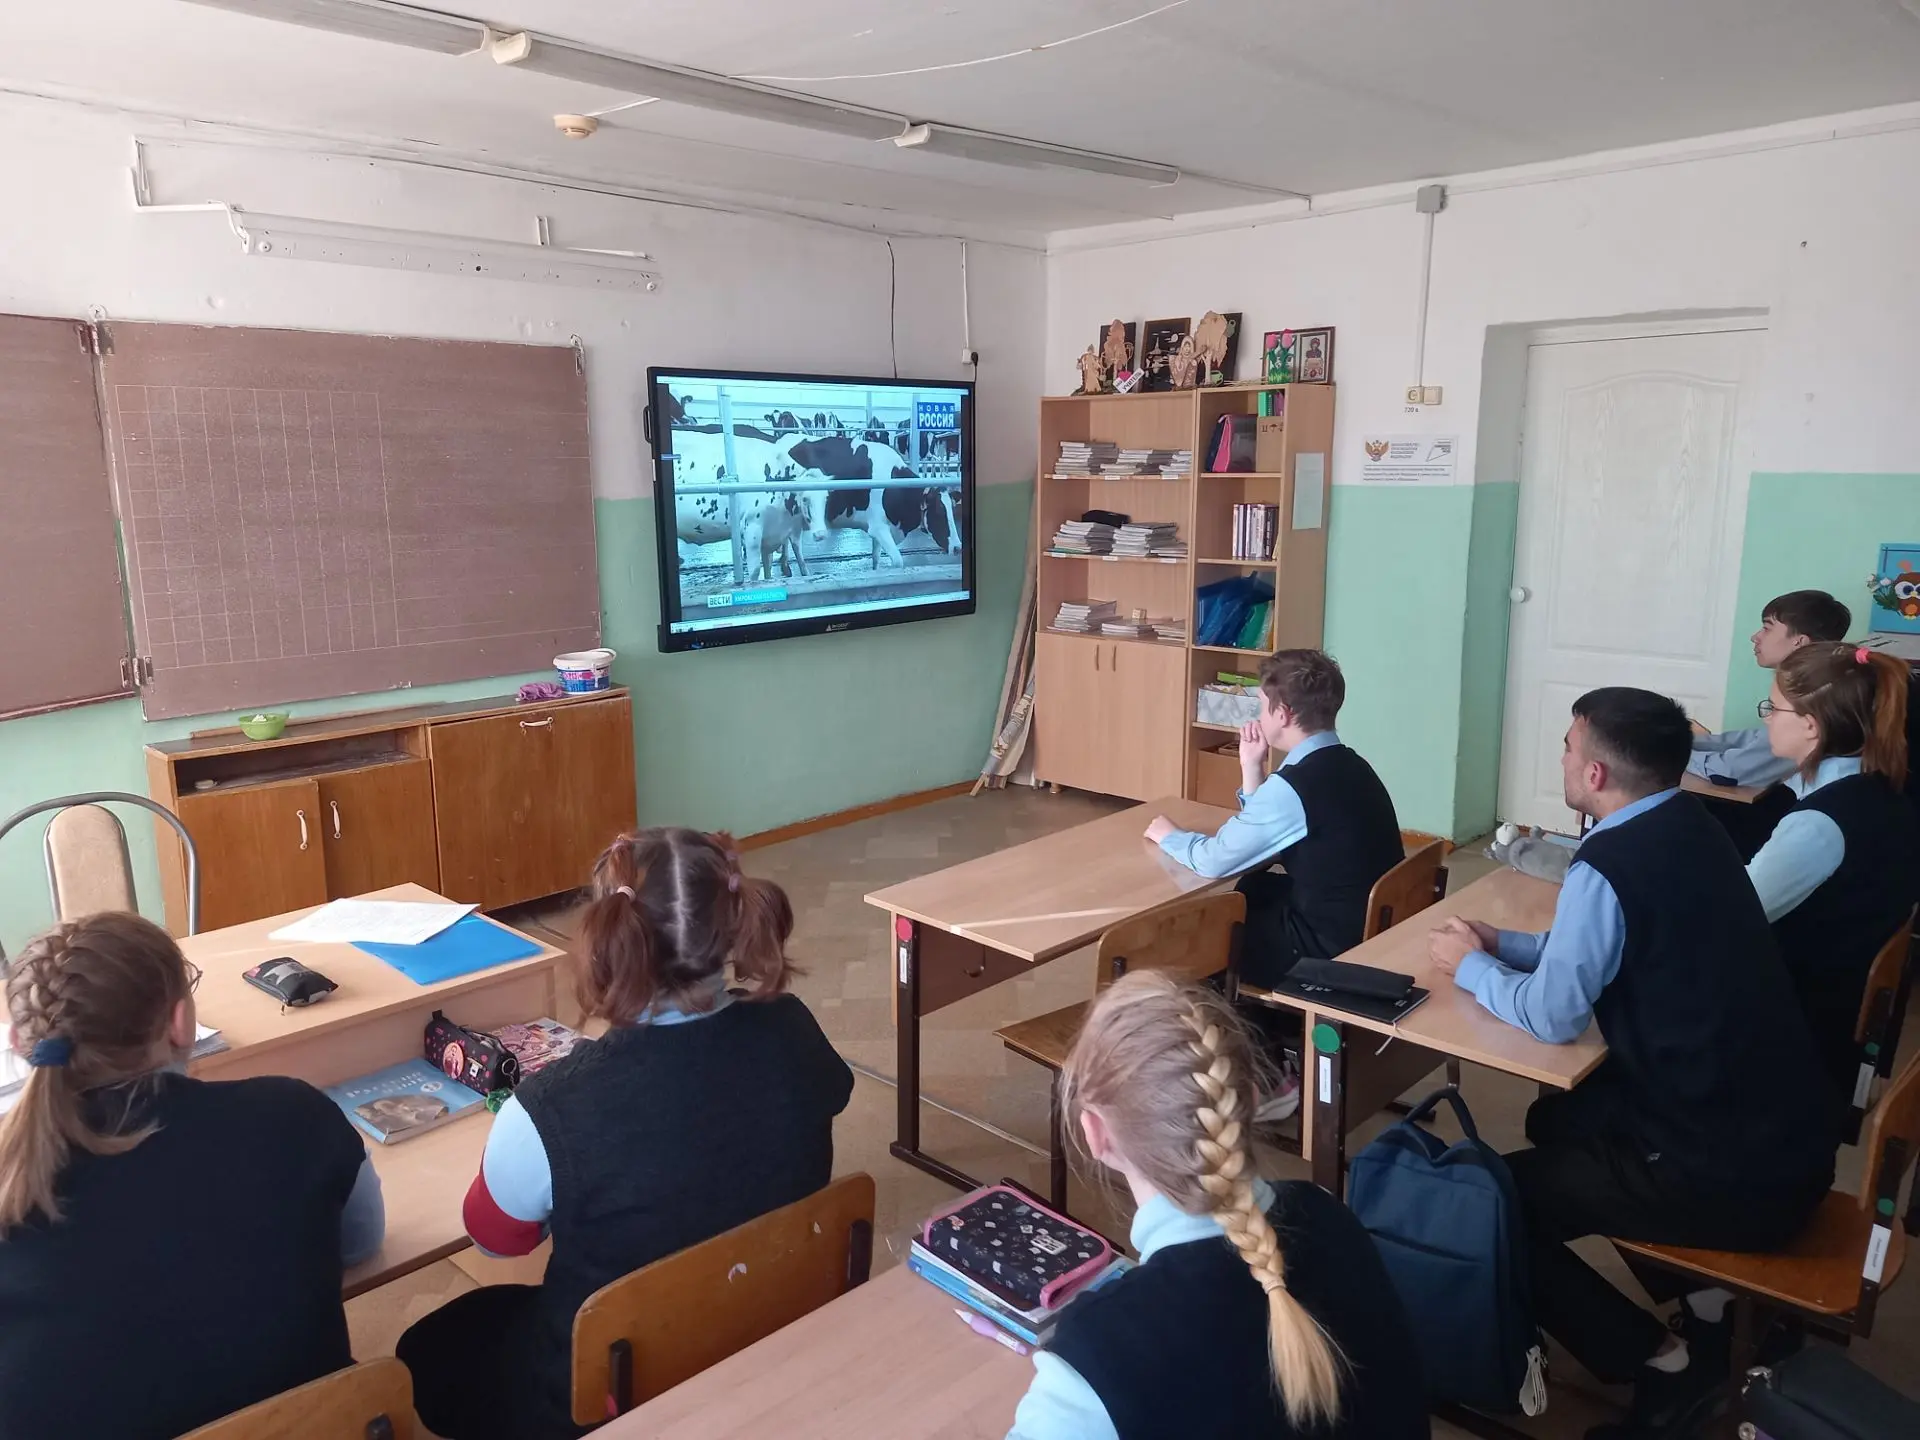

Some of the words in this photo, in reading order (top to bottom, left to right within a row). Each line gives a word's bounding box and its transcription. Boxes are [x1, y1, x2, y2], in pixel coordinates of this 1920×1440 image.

[918, 404, 954, 412] НОВАЯ
[919, 412, 954, 428] РОССИЯ
[709, 595, 731, 606] ВЕСТИ
